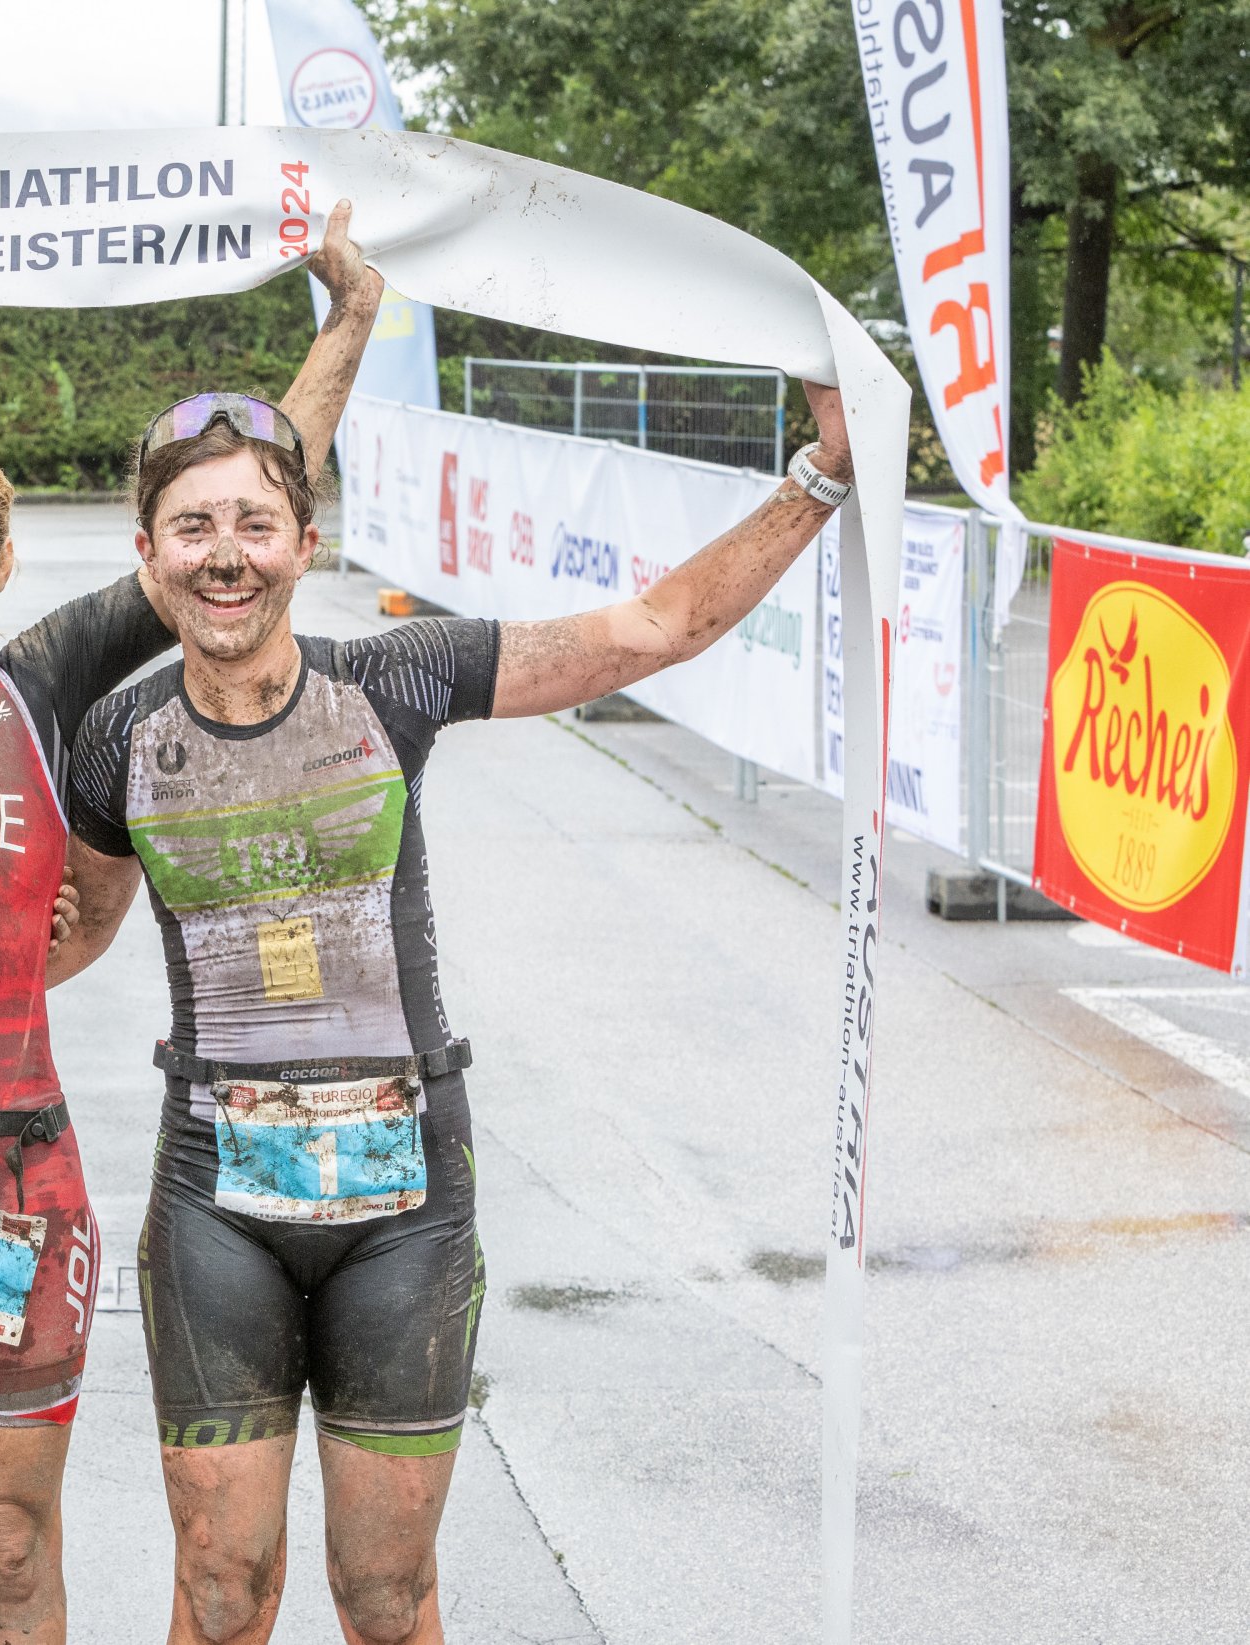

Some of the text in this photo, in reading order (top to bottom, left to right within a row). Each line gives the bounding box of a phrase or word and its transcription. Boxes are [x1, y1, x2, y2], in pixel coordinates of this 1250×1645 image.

[279, 160, 310, 258] 2024
[1063, 647, 1216, 822] Recheis
[1112, 833, 1157, 894] 1889
[830, 835, 864, 1241] www.triathlon-austria.at
[312, 1088, 373, 1104] EUREGIO
[306, 1131, 338, 1195] 1
[66, 1214, 92, 1335] JOL
